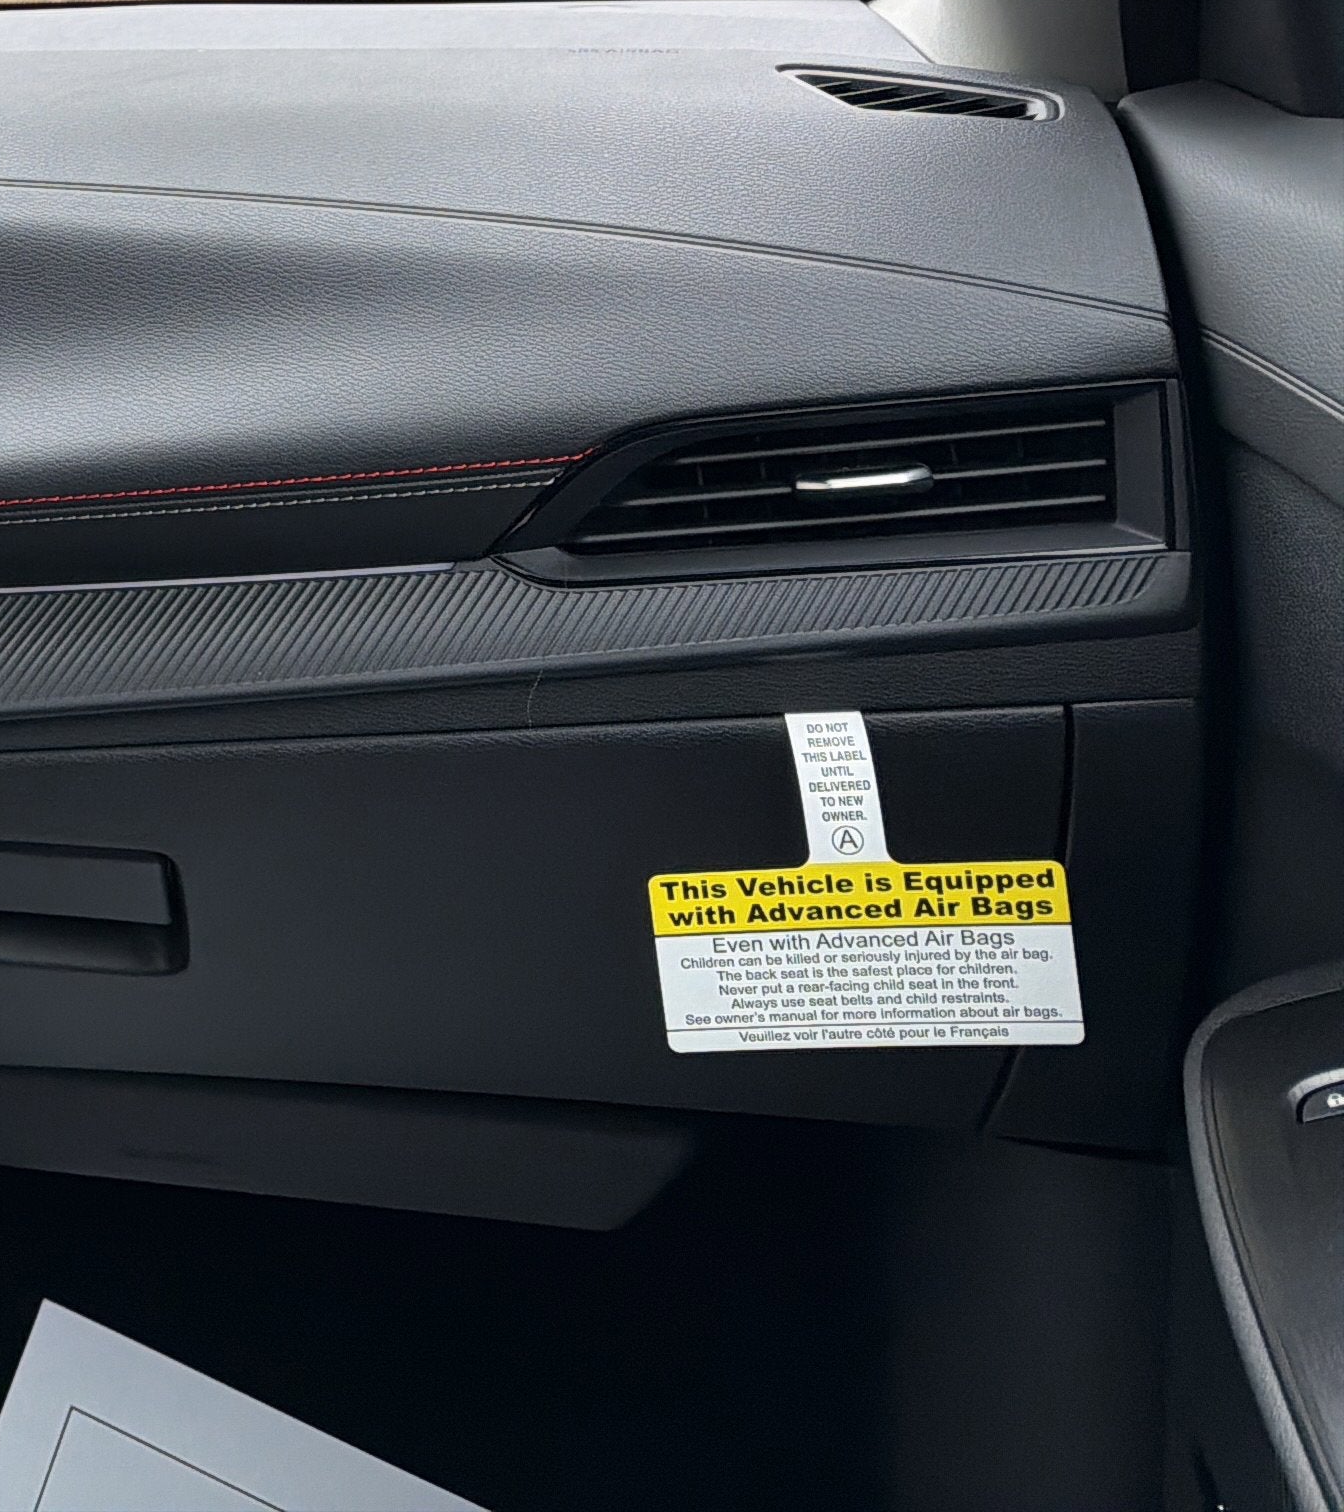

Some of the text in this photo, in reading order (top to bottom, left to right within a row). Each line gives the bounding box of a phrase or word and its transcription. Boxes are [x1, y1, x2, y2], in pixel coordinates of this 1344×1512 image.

[806, 722, 848, 734] DO NOT
[807, 736, 855, 748] REMOVE
[801, 750, 867, 763] THIS LABEL
[821, 766, 854, 777] UNTIL
[808, 779, 871, 793] DELIVERED
[819, 795, 863, 807] TO NEW
[821, 810, 868, 822] OWNER.
[839, 829, 859, 850] A
[660, 868, 1055, 901] This Vehicle is Equipped
[668, 896, 1053, 927] with Advanced Air Bags
[712, 929, 1015, 954] Even with Advanced Air Bags
[680, 948, 1053, 970] Children can be killed or seriously injured by the air bag.
[716, 963, 1018, 982] The back seat is the safest place for children.
[718, 977, 1020, 997] Never put a rear-facing child seat in the front.
[731, 992, 1010, 1011] Always use seat belts and child restraints.
[685, 1005, 1063, 1025] See owner's manual for more information about air bags.
[738, 1025, 1010, 1042] Veuillez voir l'autre côté pour le Français
